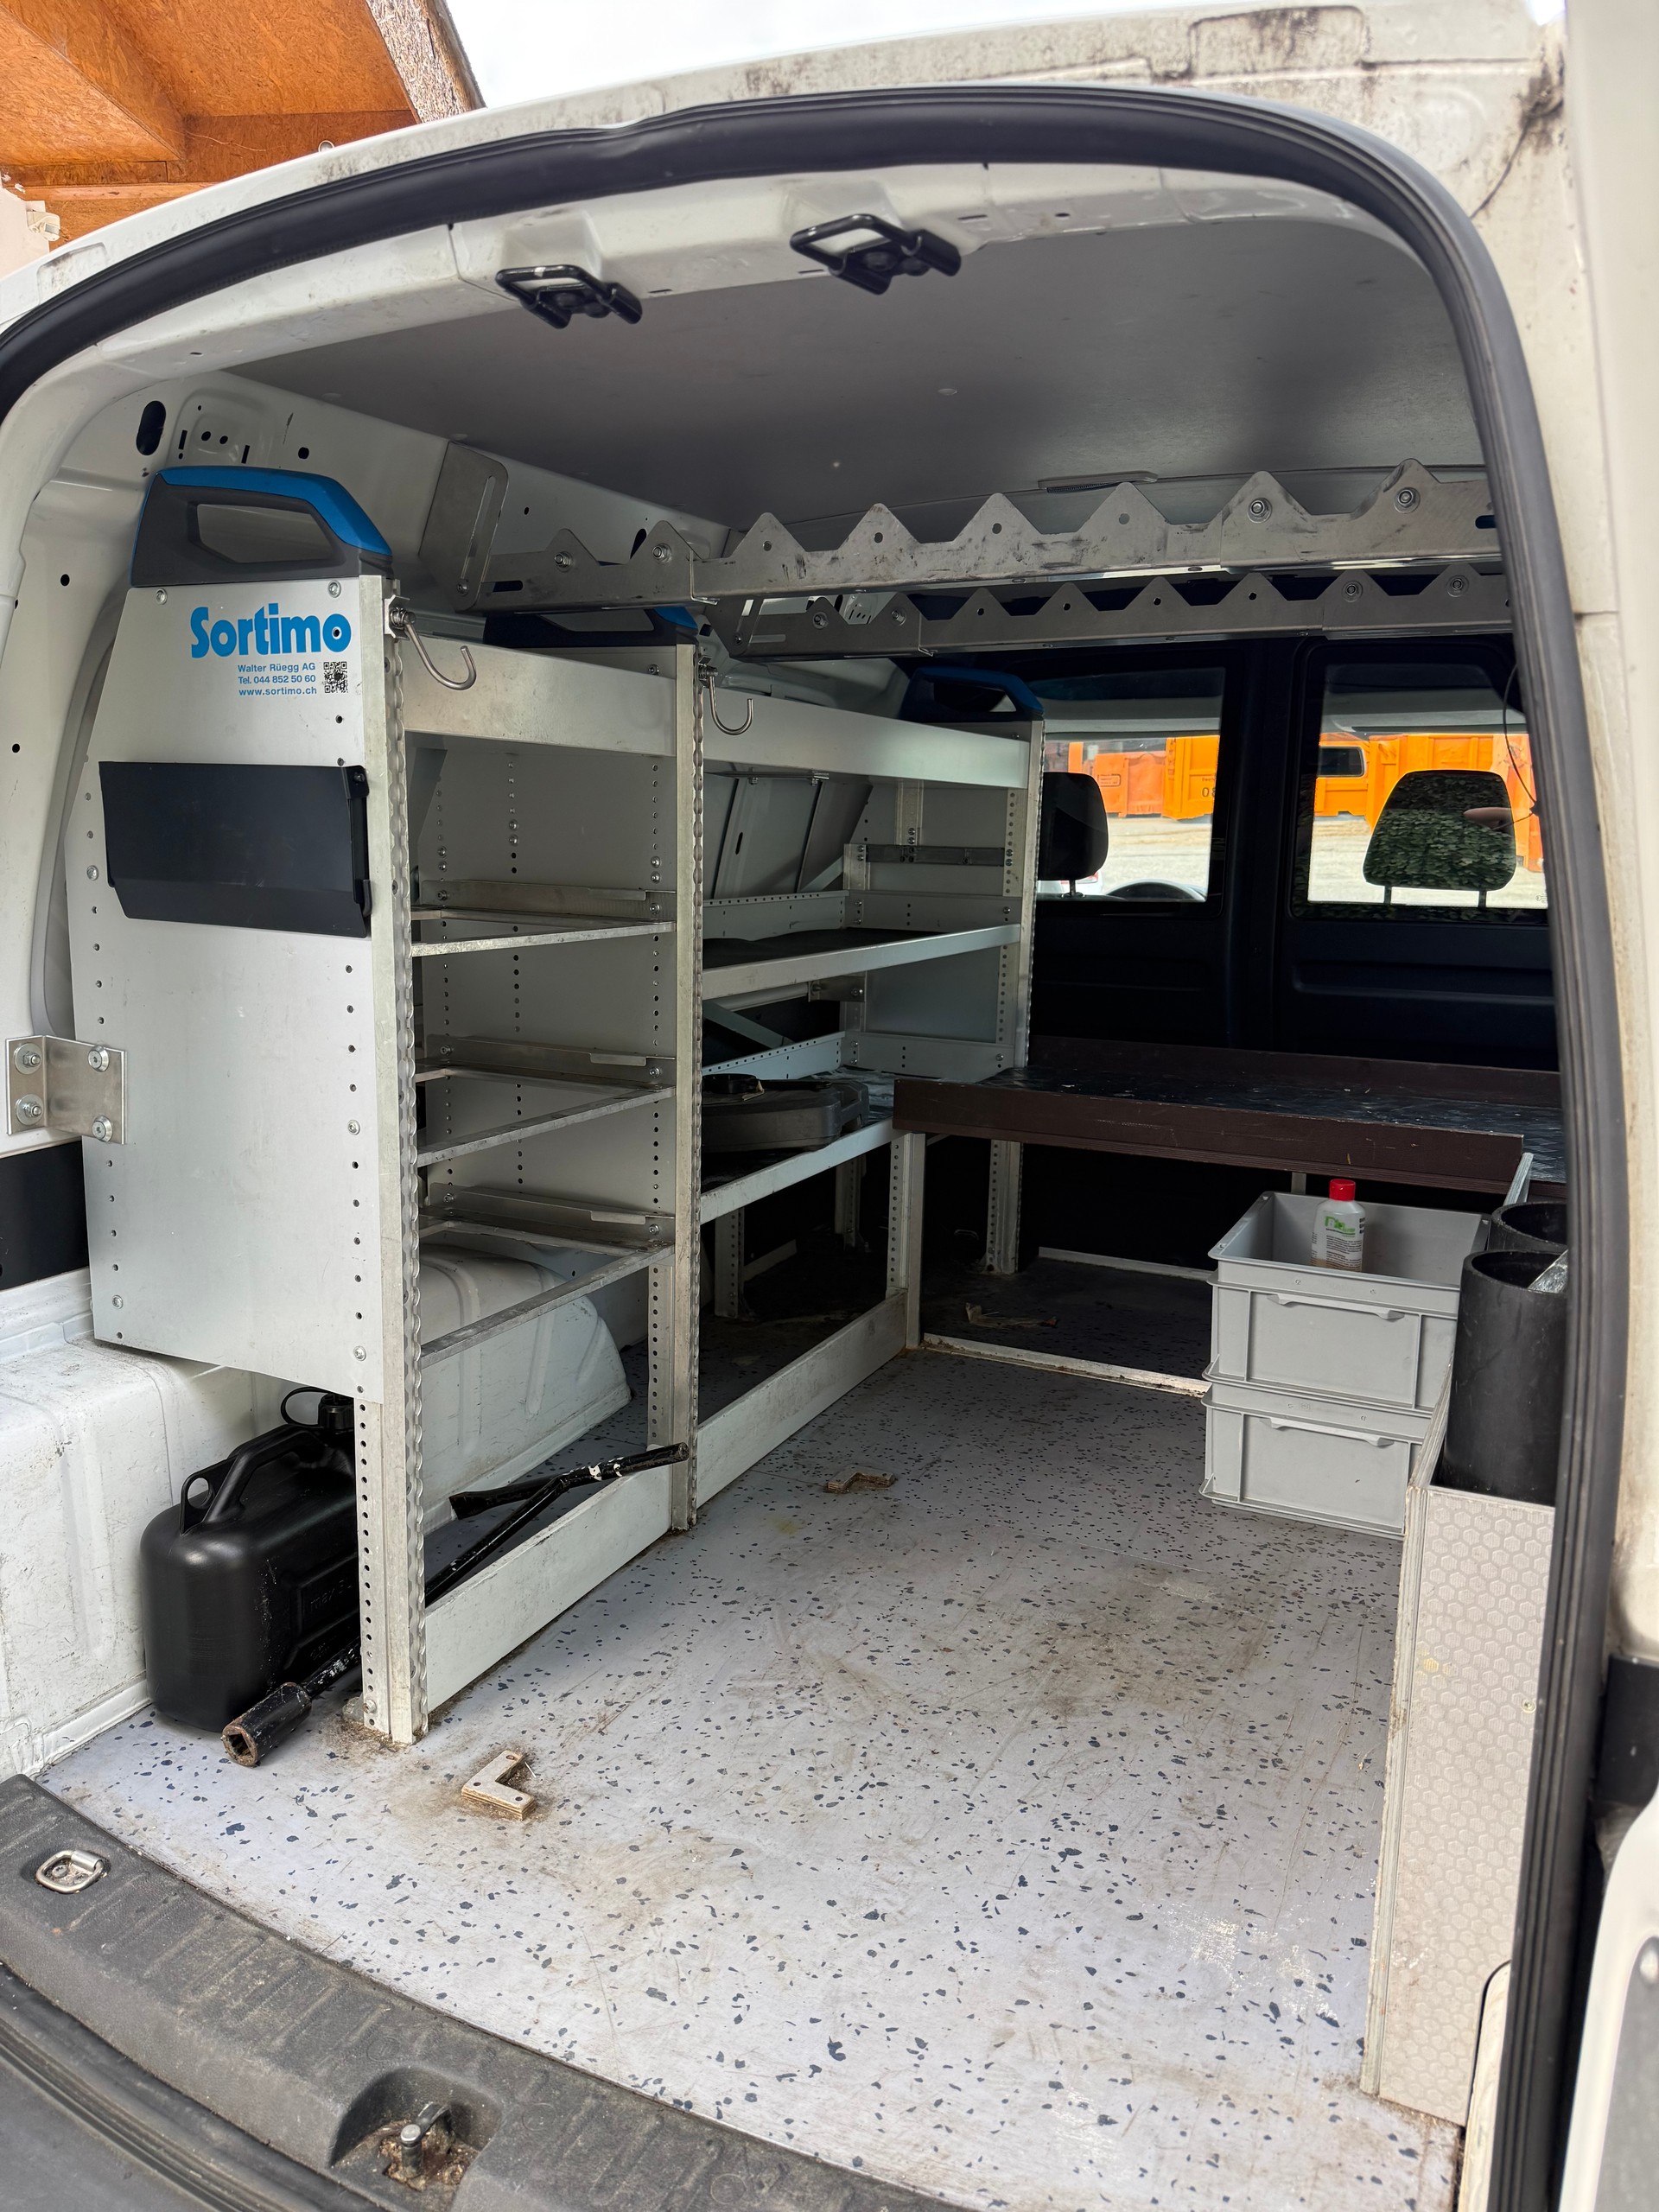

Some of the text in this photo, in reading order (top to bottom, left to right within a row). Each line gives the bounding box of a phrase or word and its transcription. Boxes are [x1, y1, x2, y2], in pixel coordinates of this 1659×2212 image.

[190, 603, 352, 659] Sortimo
[238, 663, 316, 673] Walter Rüegg AG
[239, 687, 317, 696] www.sortimo.ch
